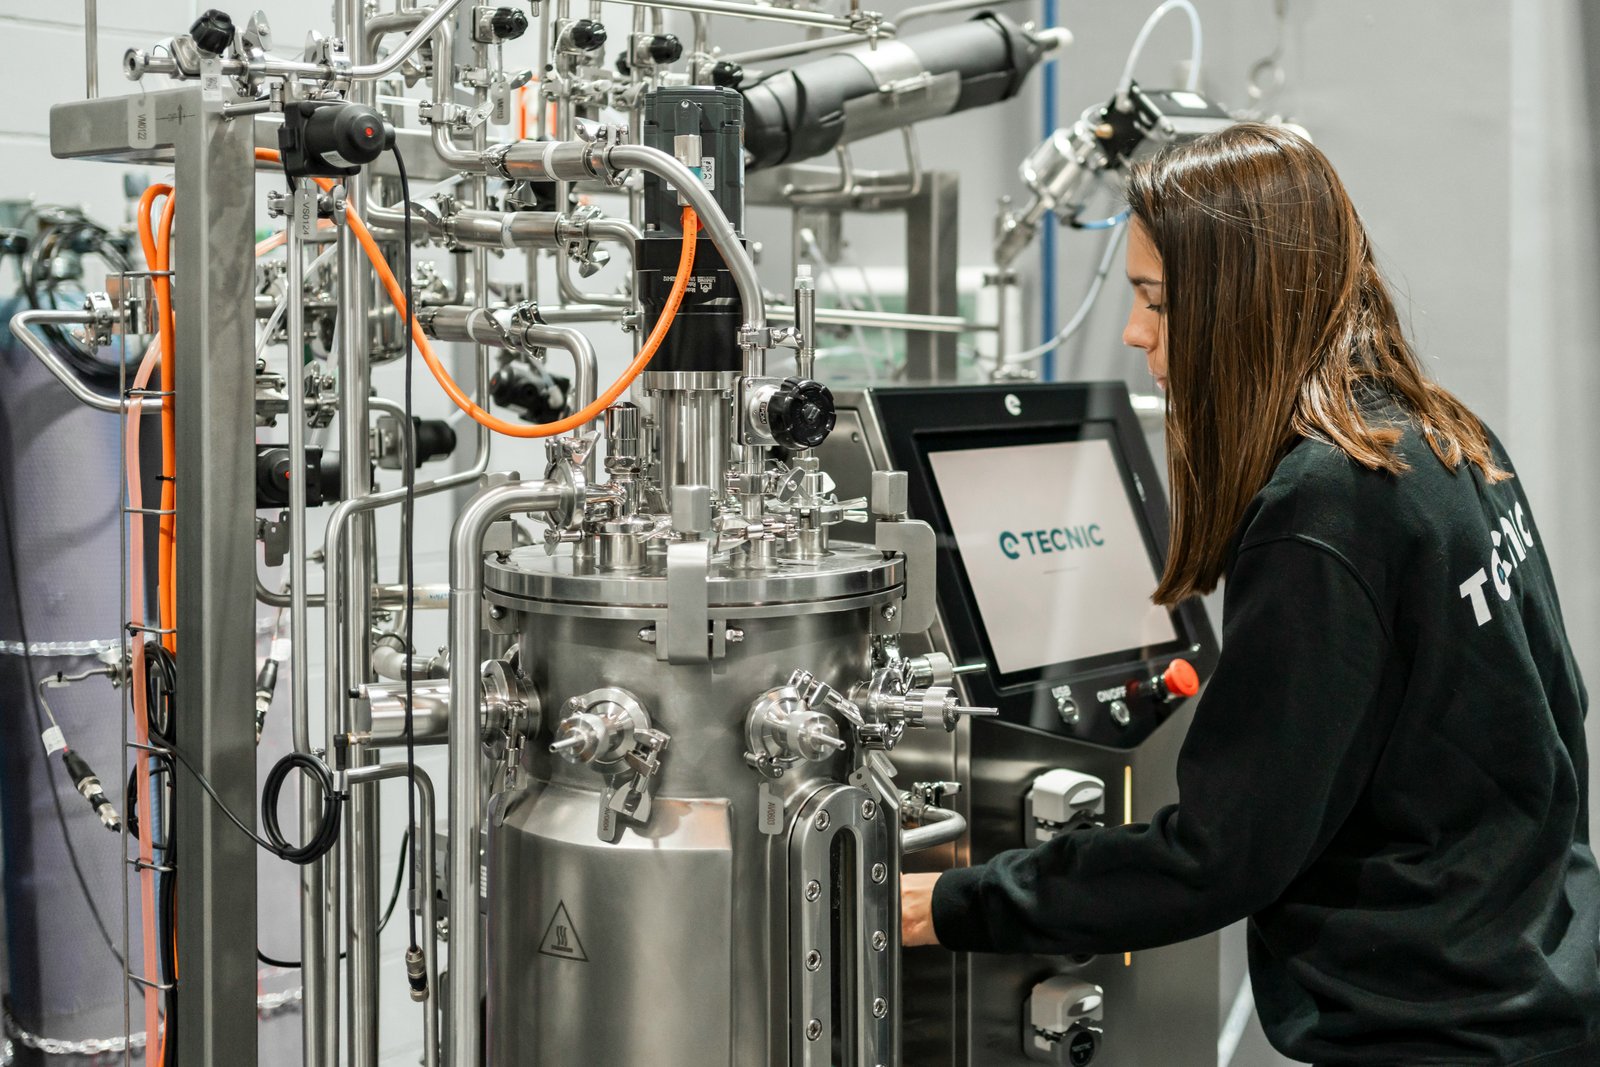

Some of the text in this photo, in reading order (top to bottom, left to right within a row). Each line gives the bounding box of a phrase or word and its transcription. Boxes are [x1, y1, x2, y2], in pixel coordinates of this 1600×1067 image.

[137, 113, 147, 140] VM0122
[302, 202, 310, 235] VS0124
[1021, 524, 1104, 555] TECNIC
[767, 801, 776, 826] AV0603
